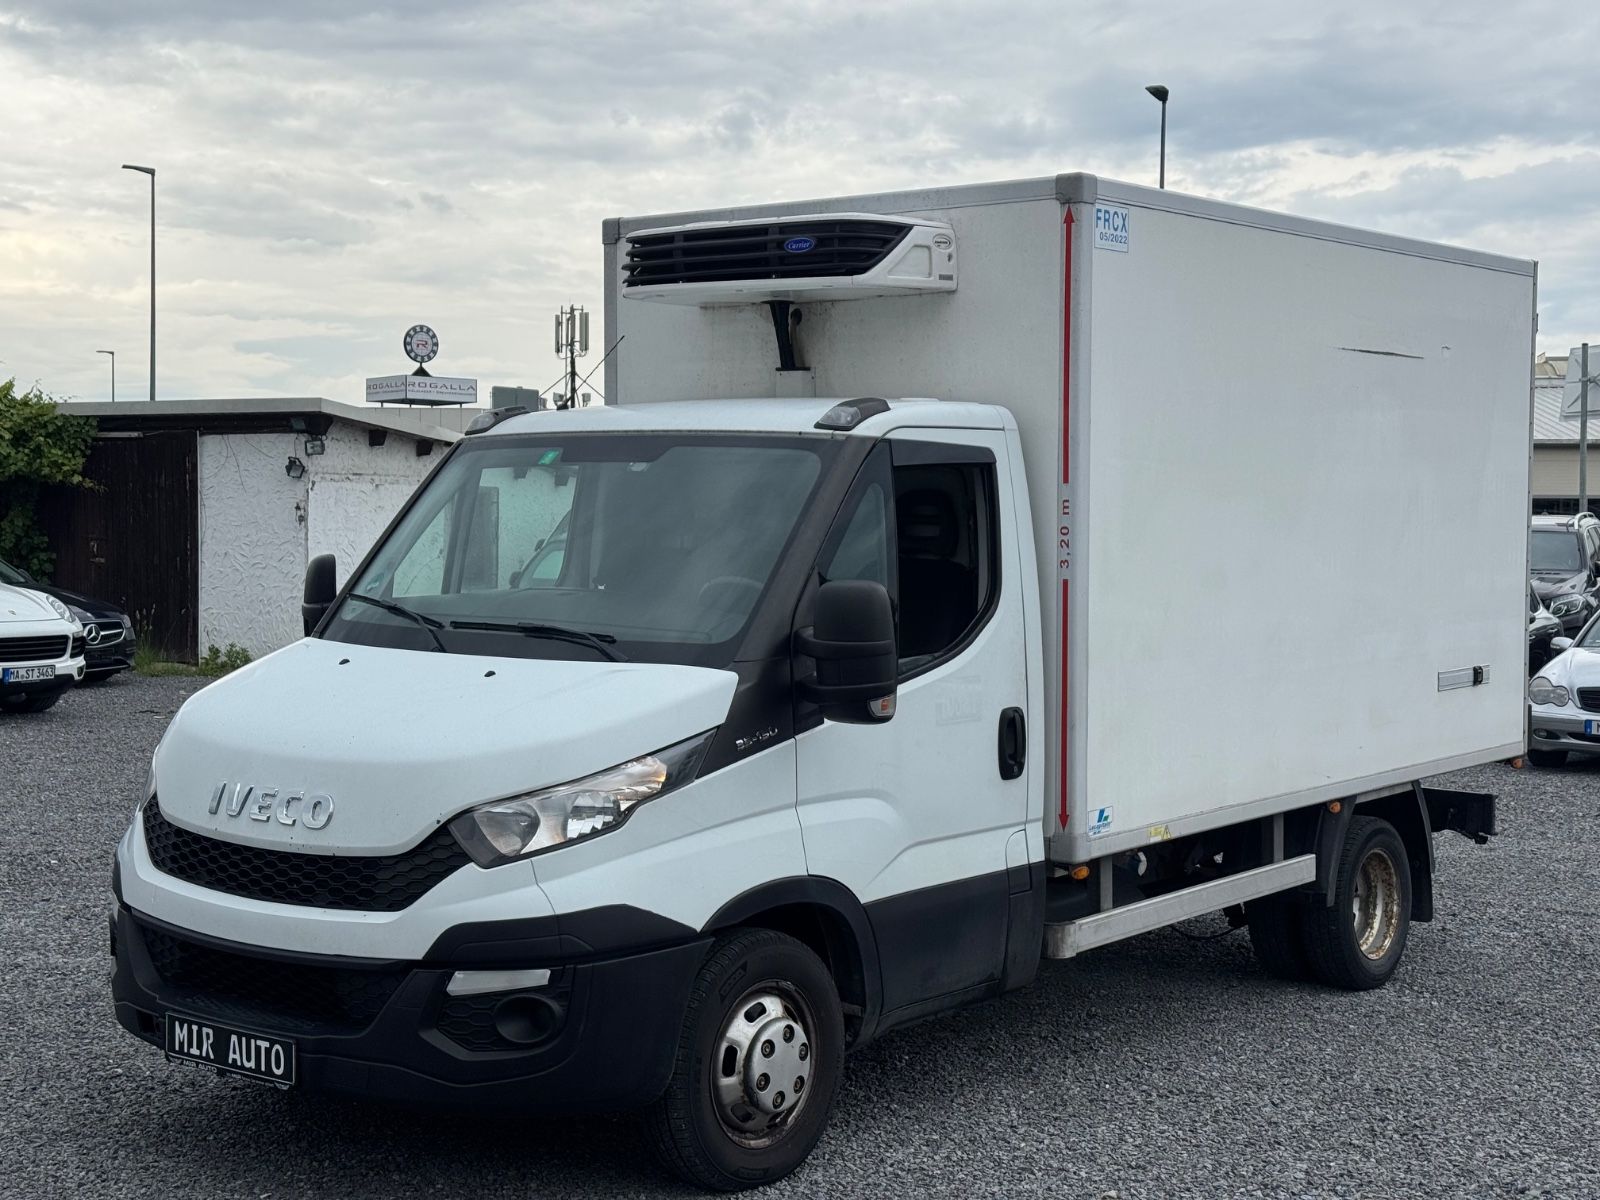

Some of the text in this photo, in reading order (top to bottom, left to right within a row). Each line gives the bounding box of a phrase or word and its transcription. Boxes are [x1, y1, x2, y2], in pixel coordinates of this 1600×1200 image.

[1096, 208, 1128, 233] FRCX
[788, 240, 810, 249] Carrier
[1100, 231, 1128, 245] 05/2022
[367, 381, 406, 391] ROGALLA
[407, 381, 476, 391] ROGALLA
[1060, 499, 1071, 569] 3,20 m
[10, 666, 54, 680] MA ST 3463
[208, 781, 335, 830] IVECO
[175, 1020, 285, 1076] MIR AUTO
